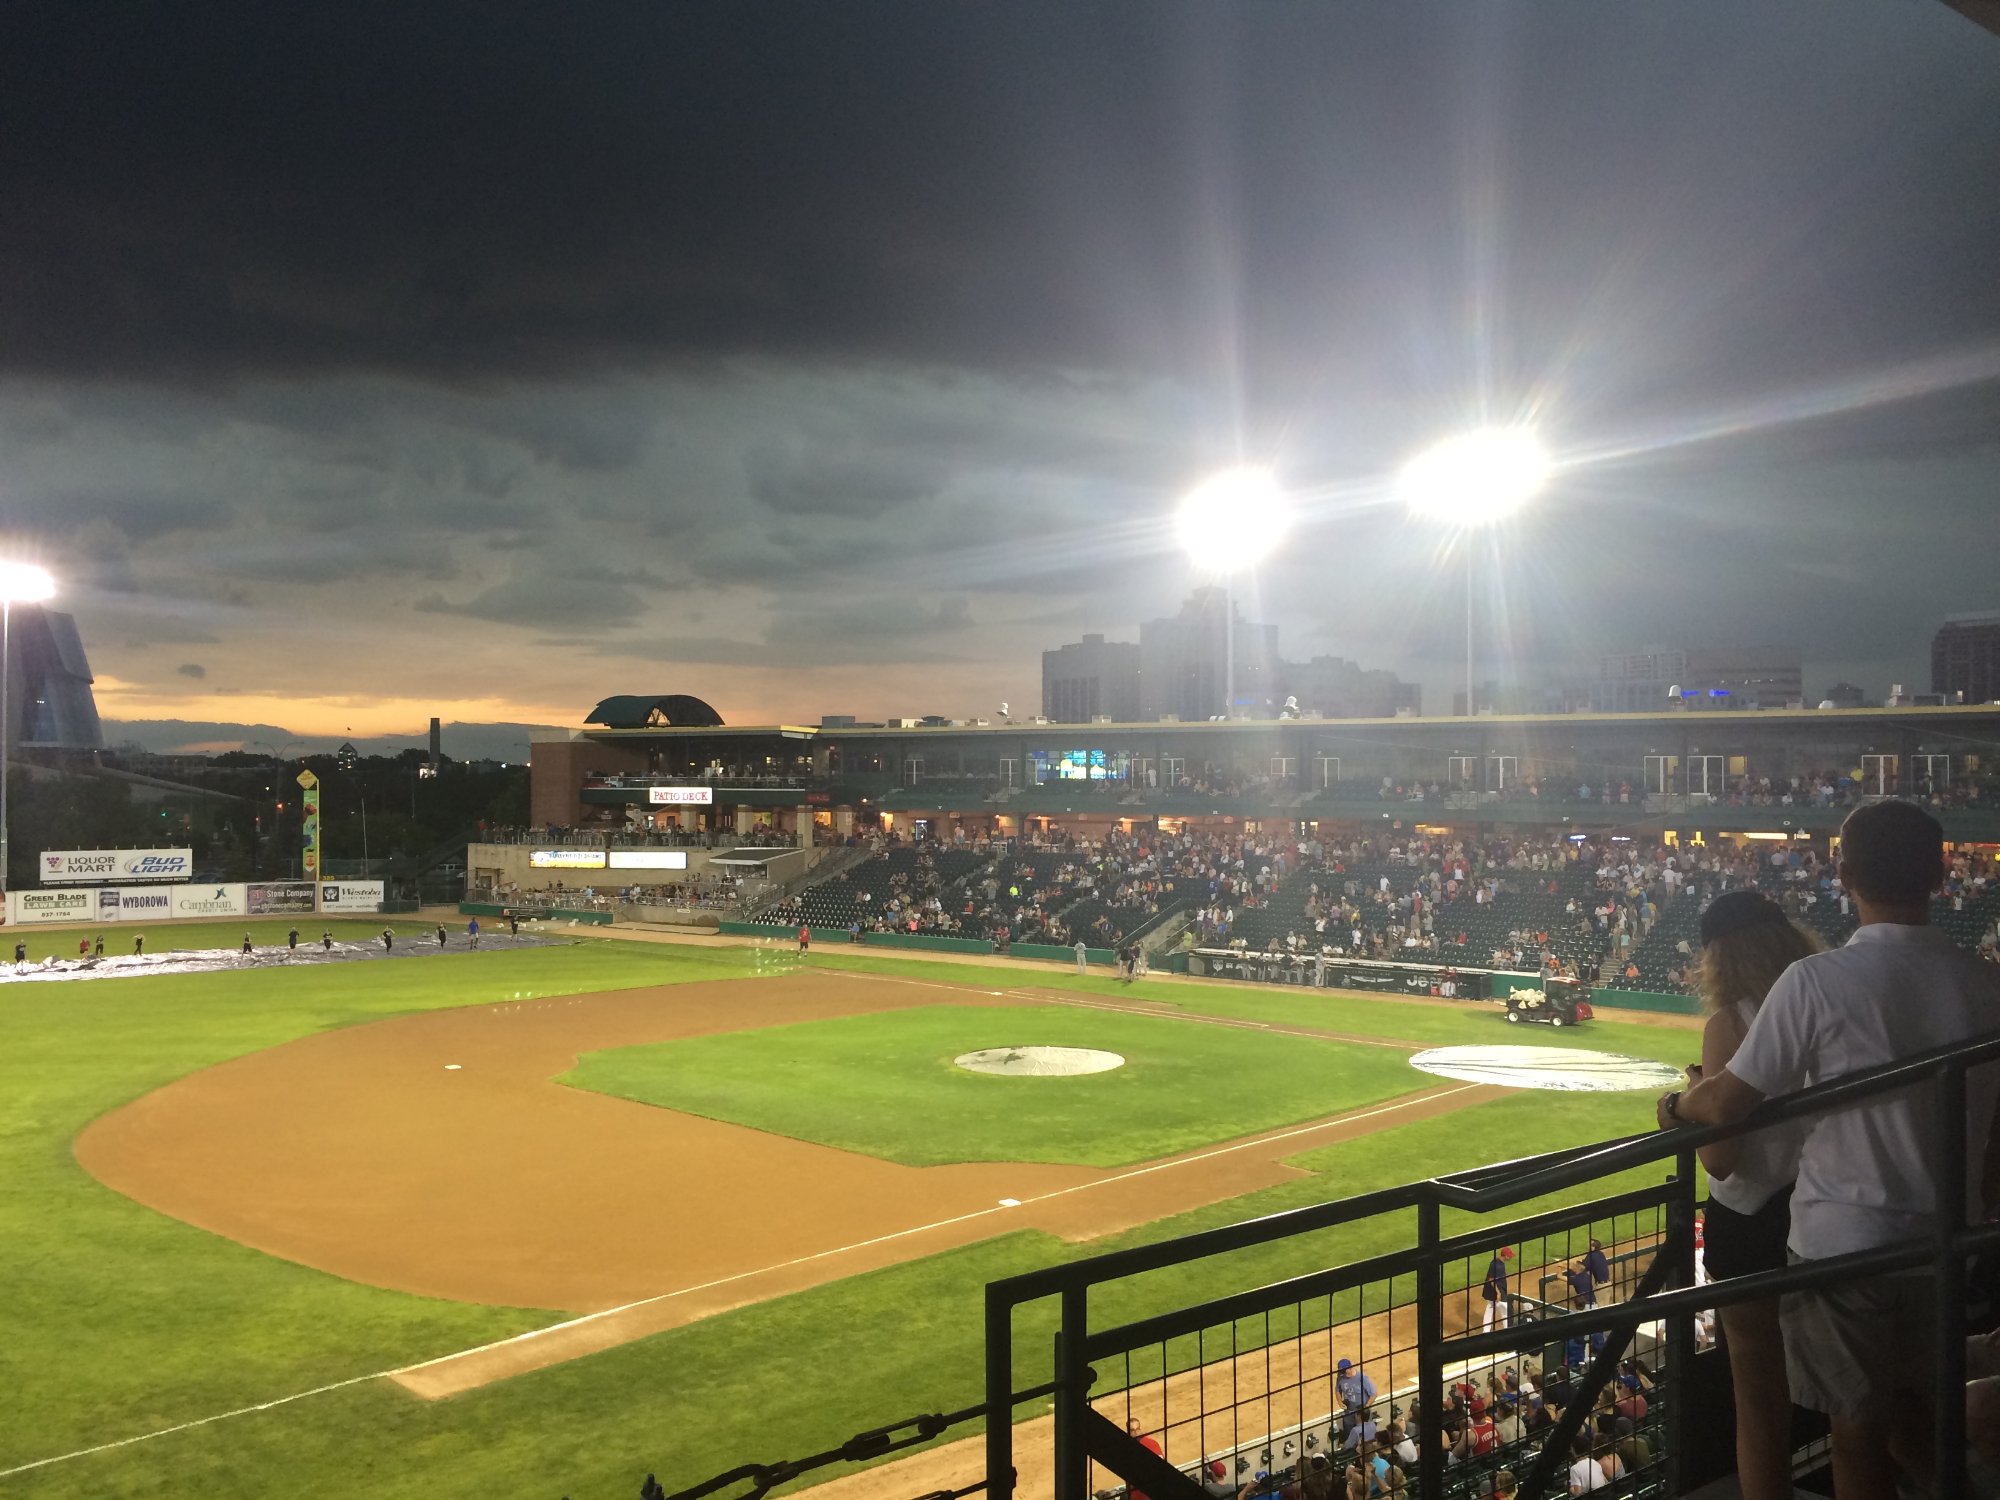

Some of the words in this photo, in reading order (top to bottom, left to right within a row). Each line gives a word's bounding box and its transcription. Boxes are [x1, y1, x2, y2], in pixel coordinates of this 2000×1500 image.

[654, 791, 681, 801] PATIO
[682, 792, 708, 801] DECK
[68, 856, 116, 865] LIQUOR
[140, 856, 185, 865] BUD
[68, 864, 116, 873] MART
[131, 864, 187, 873] LIGHT
[24, 894, 54, 902] GREEN
[58, 893, 87, 901] BLADE
[266, 889, 286, 898] Stone
[286, 889, 314, 899] Company
[27, 901, 55, 909] LAWN
[59, 900, 85, 908] CARE
[122, 895, 168, 909] WYBOROWA
[180, 899, 232, 911] Cambrian
